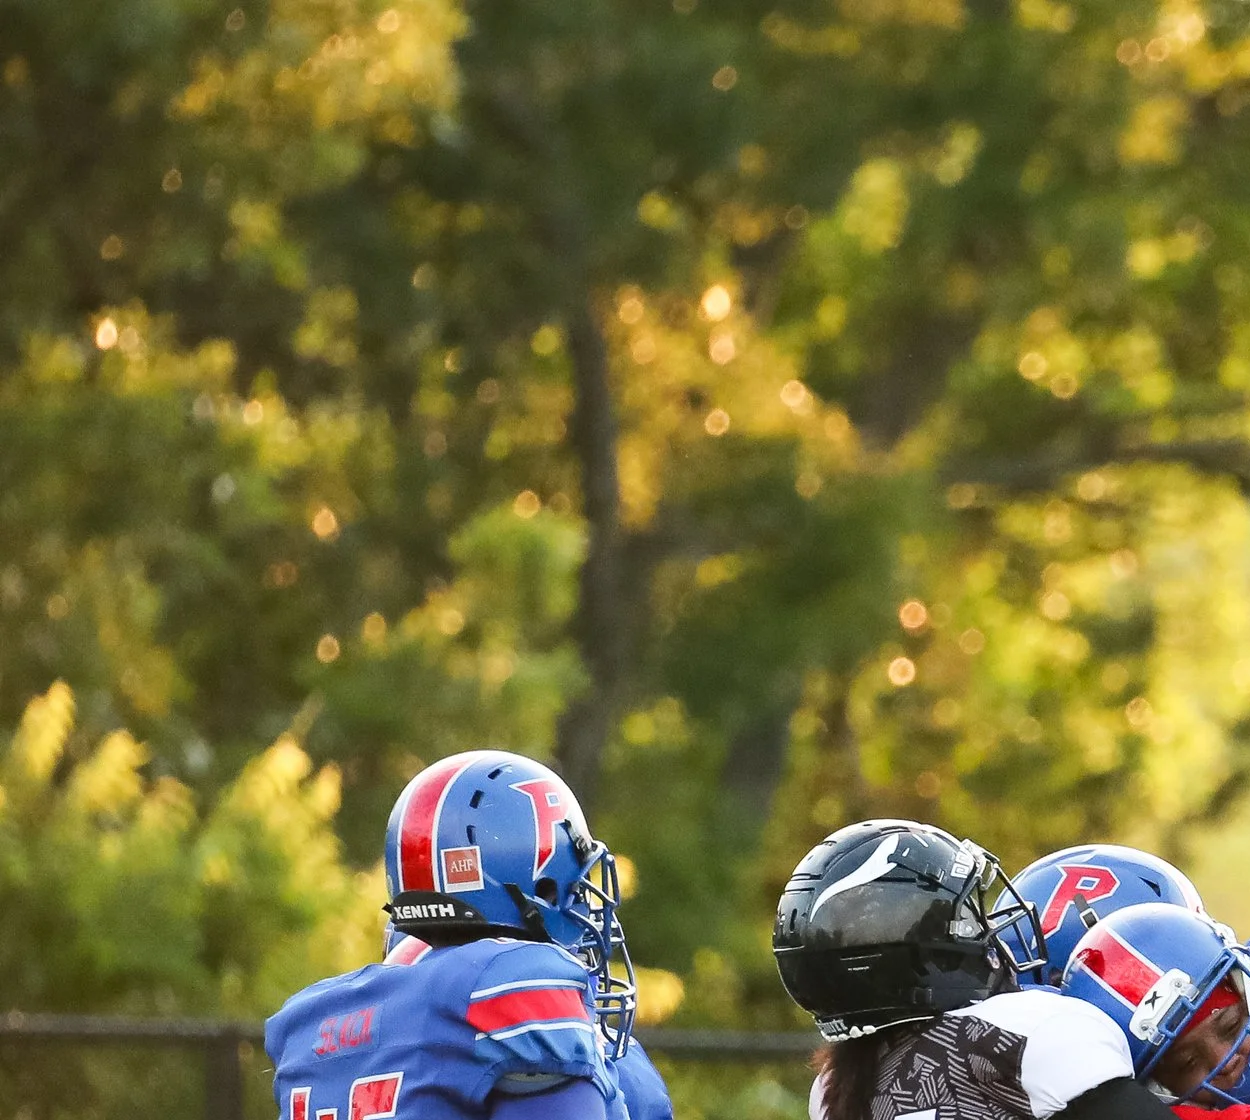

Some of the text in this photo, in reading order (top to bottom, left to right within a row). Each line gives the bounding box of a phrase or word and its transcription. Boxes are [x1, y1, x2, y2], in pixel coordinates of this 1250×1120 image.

[450, 859, 473, 873] AHF
[393, 903, 456, 920] XENITH
[1032, 864, 1121, 945] P
